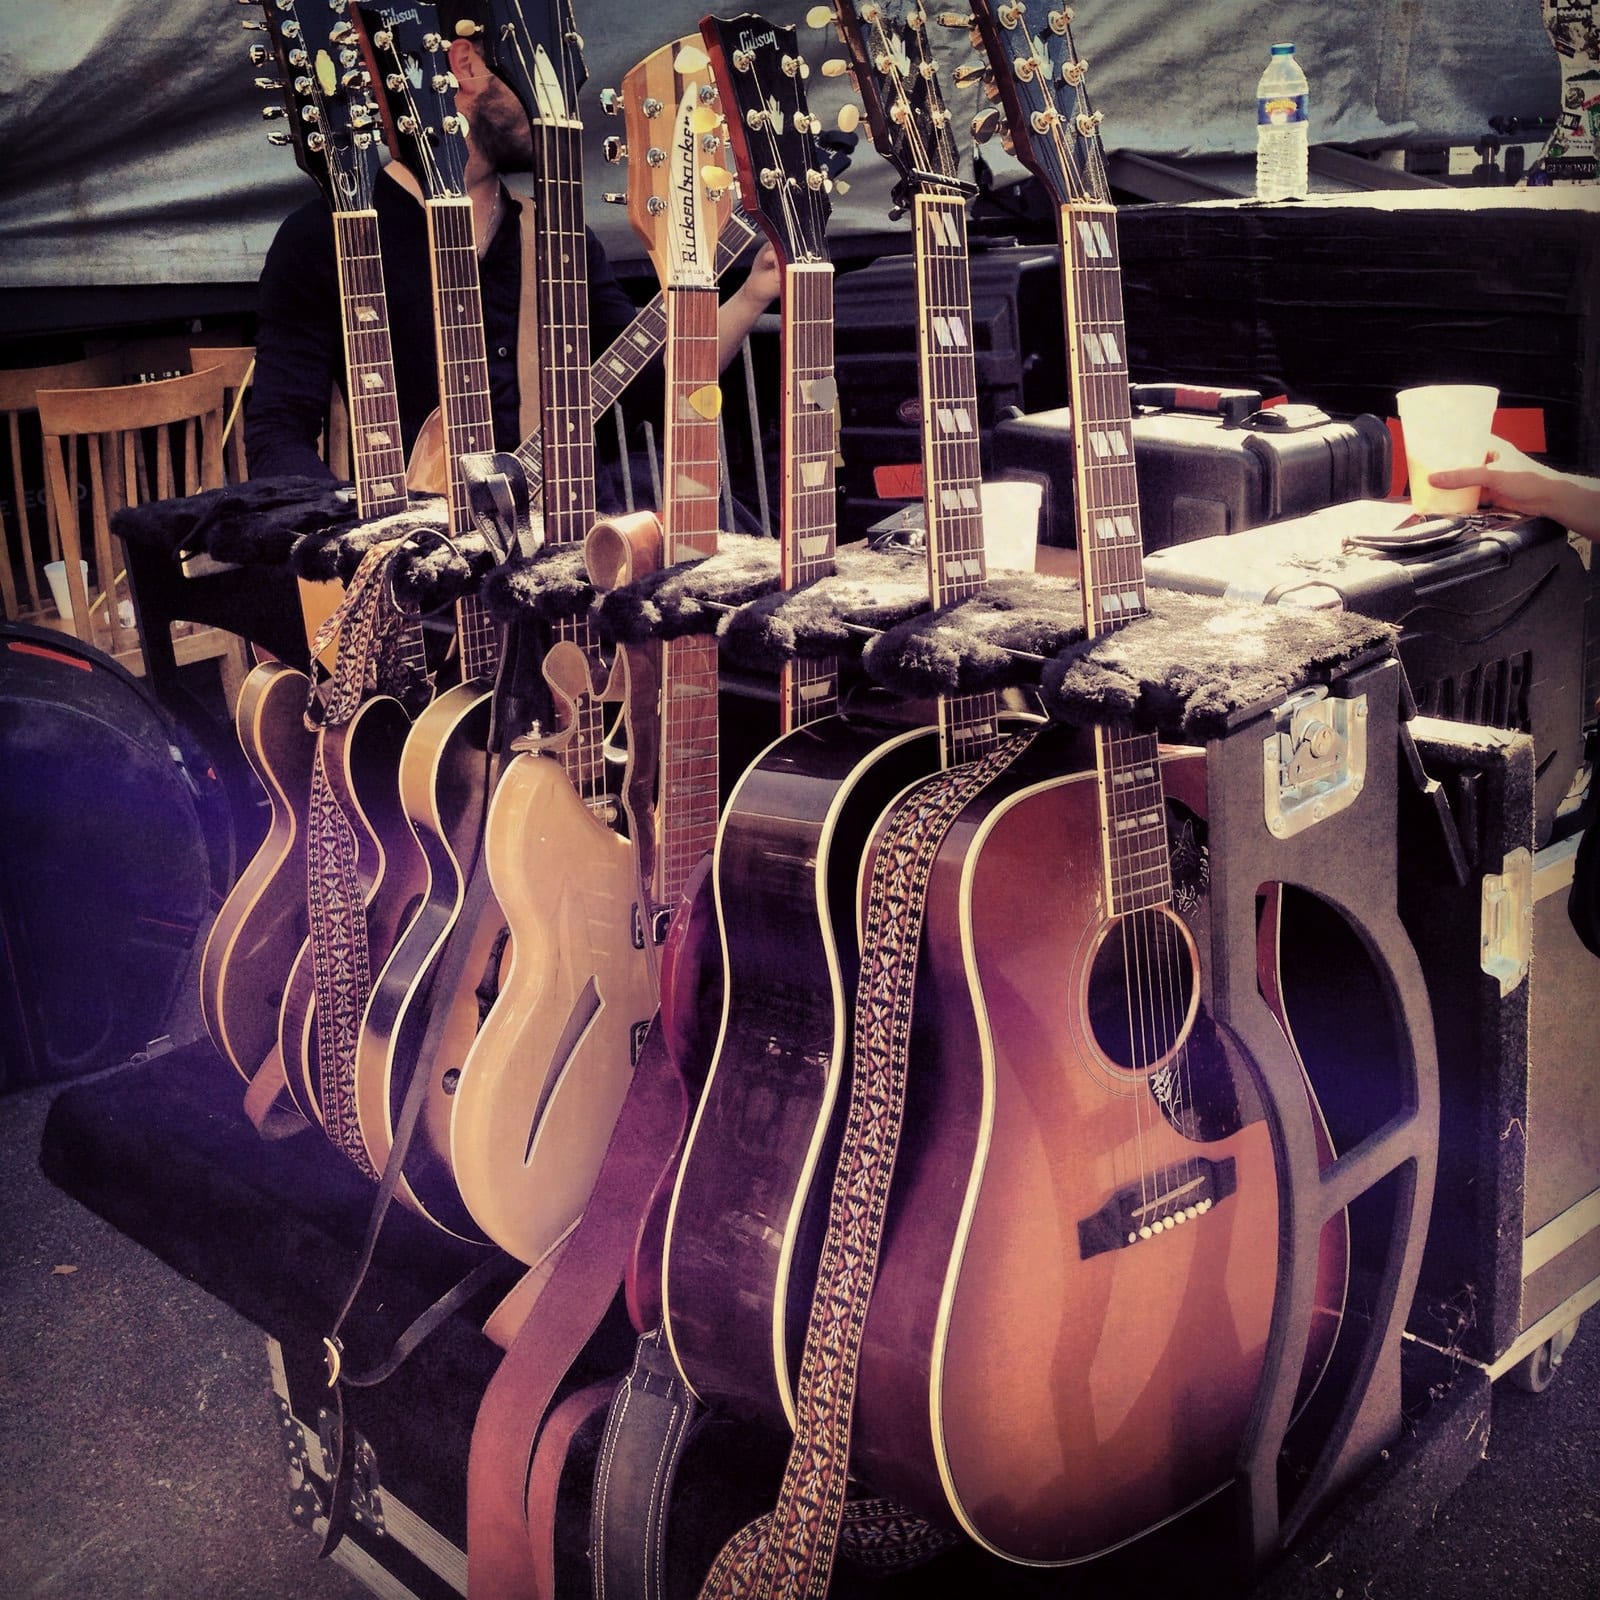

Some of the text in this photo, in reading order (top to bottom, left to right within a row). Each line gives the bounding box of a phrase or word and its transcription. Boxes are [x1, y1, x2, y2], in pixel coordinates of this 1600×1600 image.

[380, 7, 422, 29] Gibson
[739, 29, 780, 53] Gibson
[678, 117, 698, 265] Rickenbacker
